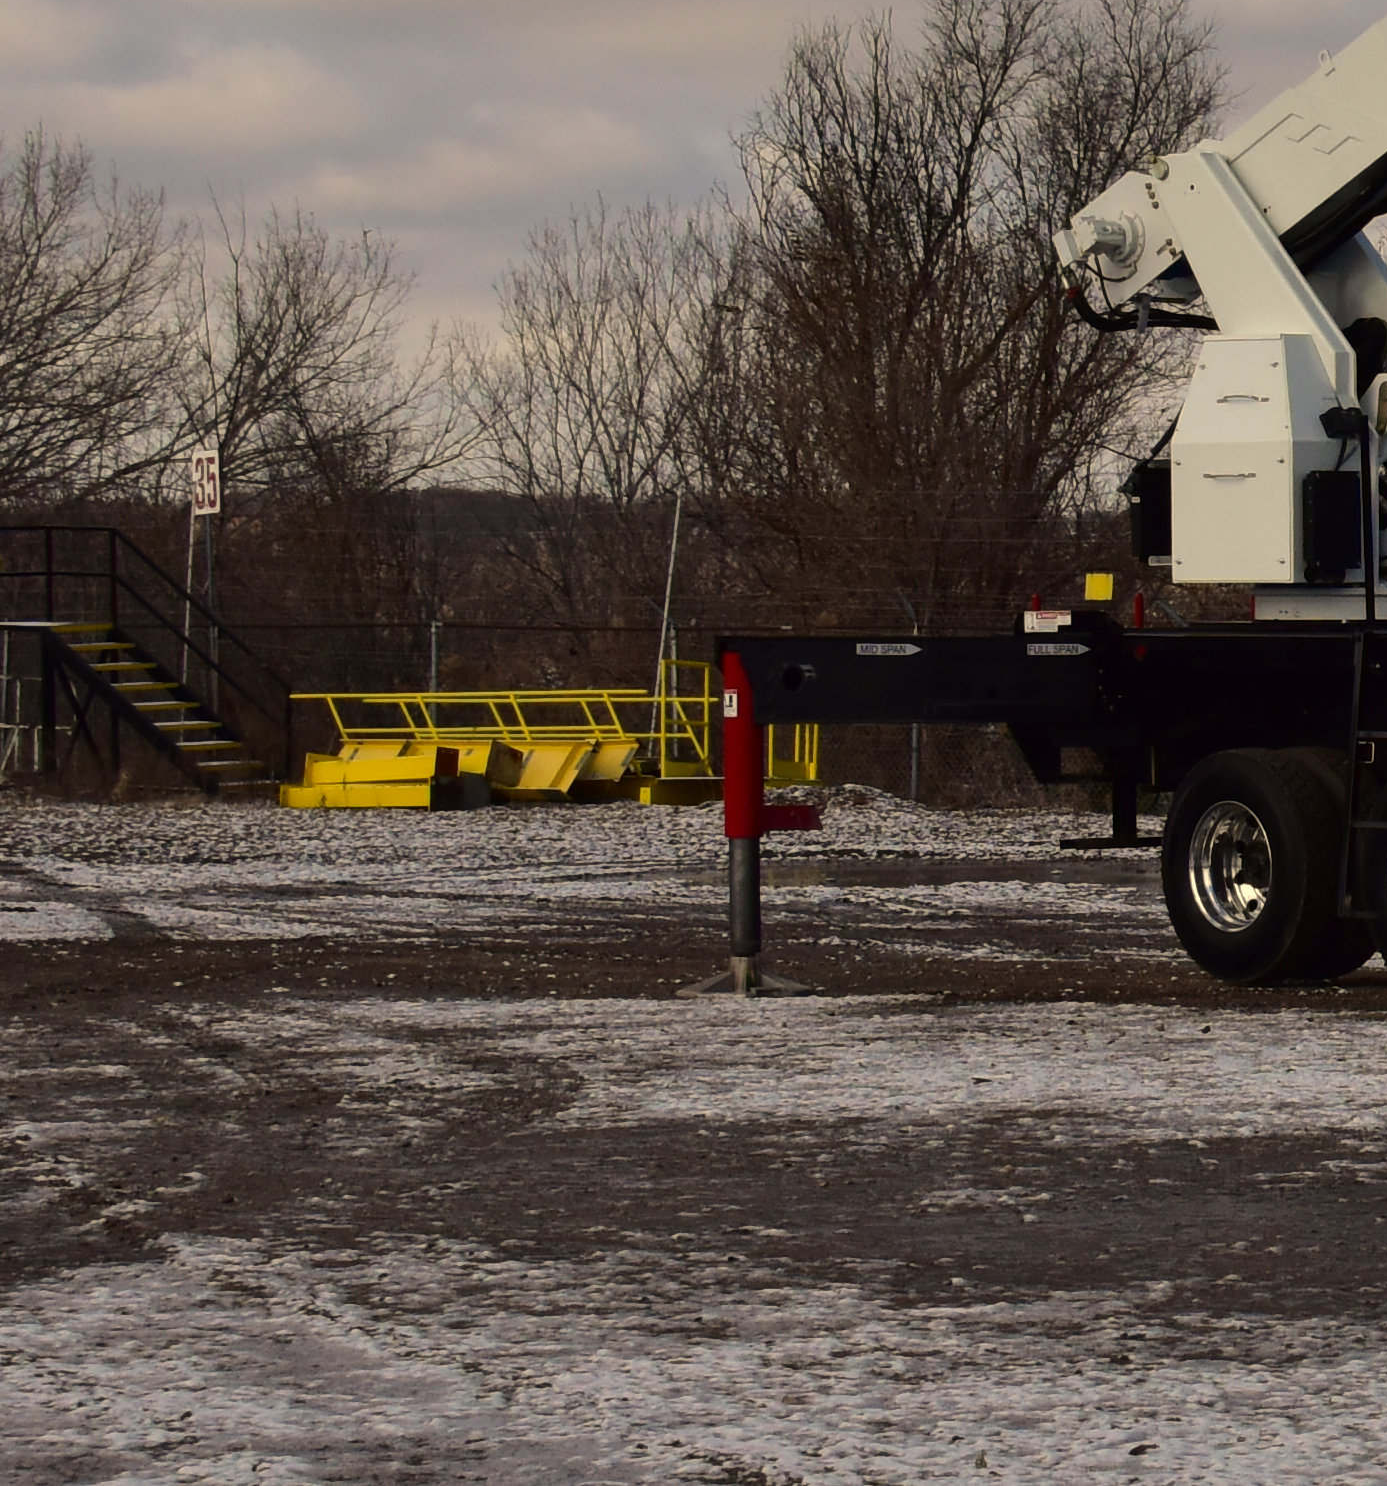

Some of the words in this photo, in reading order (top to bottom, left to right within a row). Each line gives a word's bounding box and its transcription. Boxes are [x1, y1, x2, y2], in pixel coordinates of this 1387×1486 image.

[195, 456, 218, 510] 35
[880, 644, 907, 654] SPAN
[1028, 644, 1052, 654] FULL
[1053, 644, 1079, 654] SPAN
